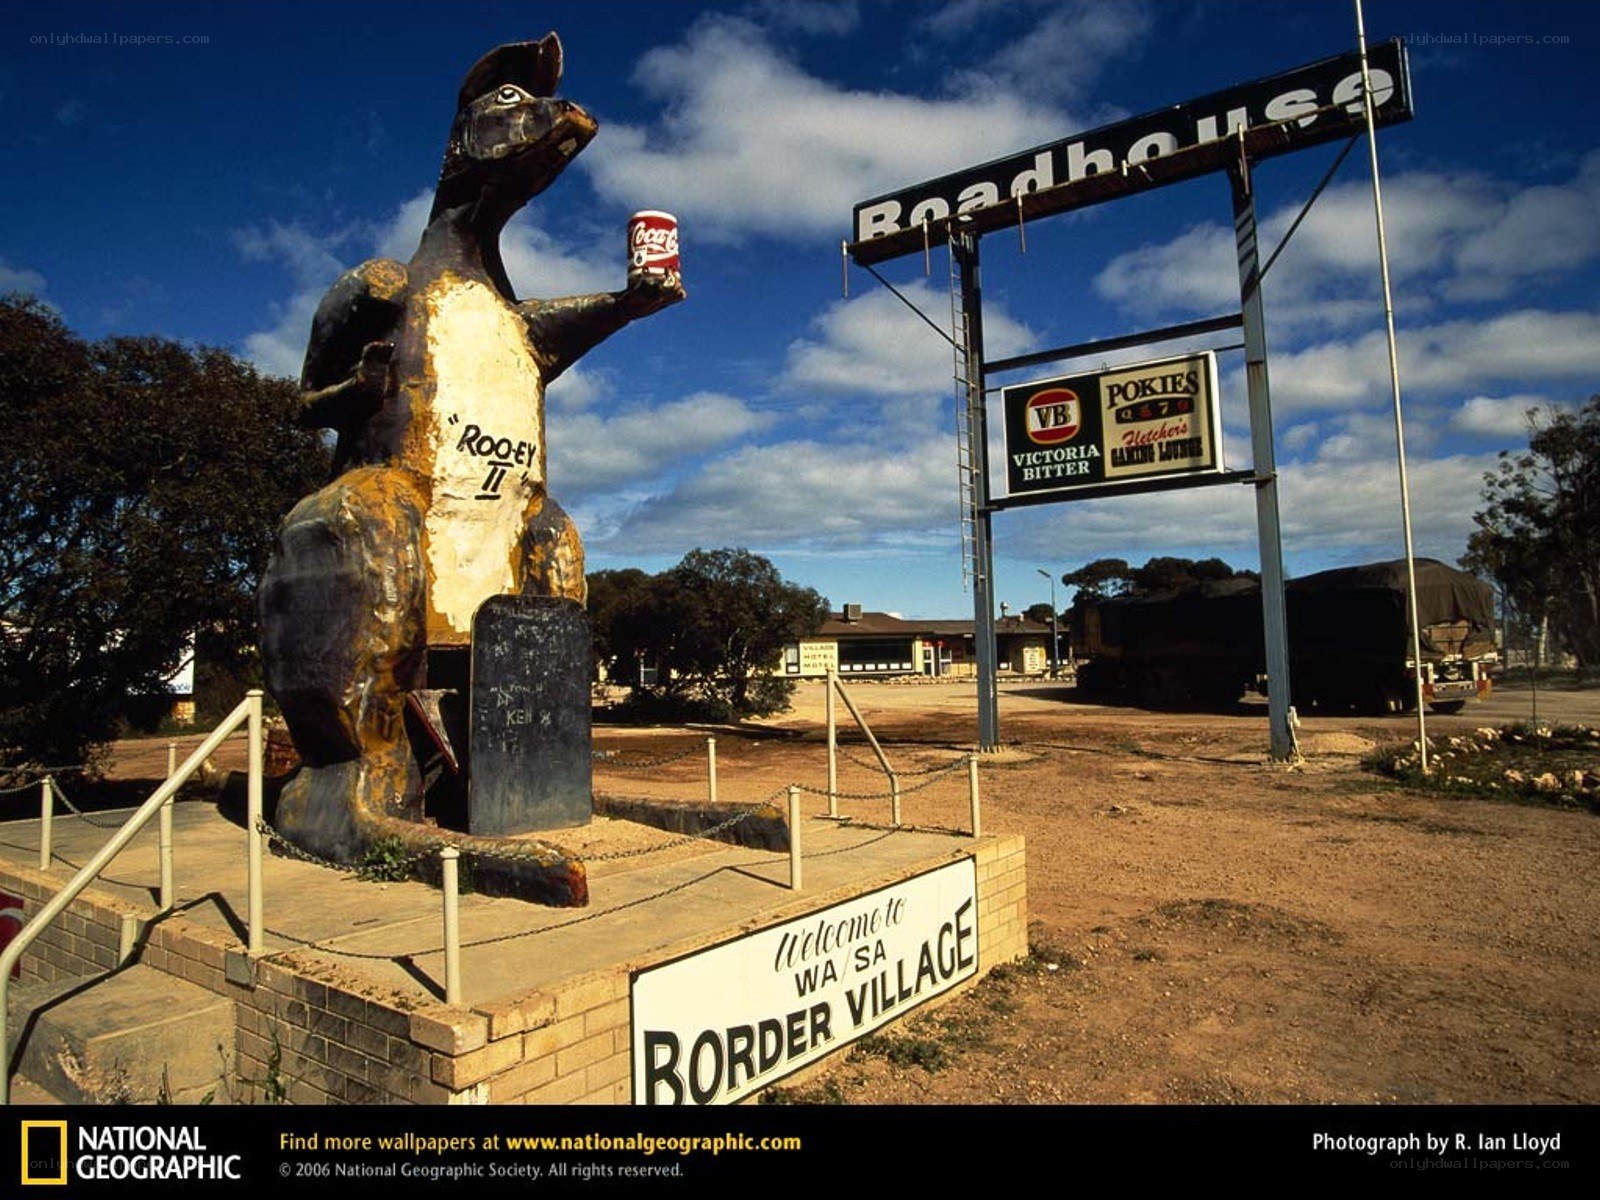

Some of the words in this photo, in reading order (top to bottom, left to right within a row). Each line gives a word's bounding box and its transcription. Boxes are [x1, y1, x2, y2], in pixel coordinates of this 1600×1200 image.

[858, 66, 1395, 241] Roadhouse
[1105, 371, 1200, 409] POKIES
[1034, 403, 1072, 429] VB
[1012, 443, 1101, 467] VICTORIA
[1022, 459, 1091, 482] BITTER
[774, 907, 881, 973] Welcome
[884, 896, 908, 932] to
[643, 1000, 834, 1105] BORDER
[844, 896, 977, 1028] VILLAGE
